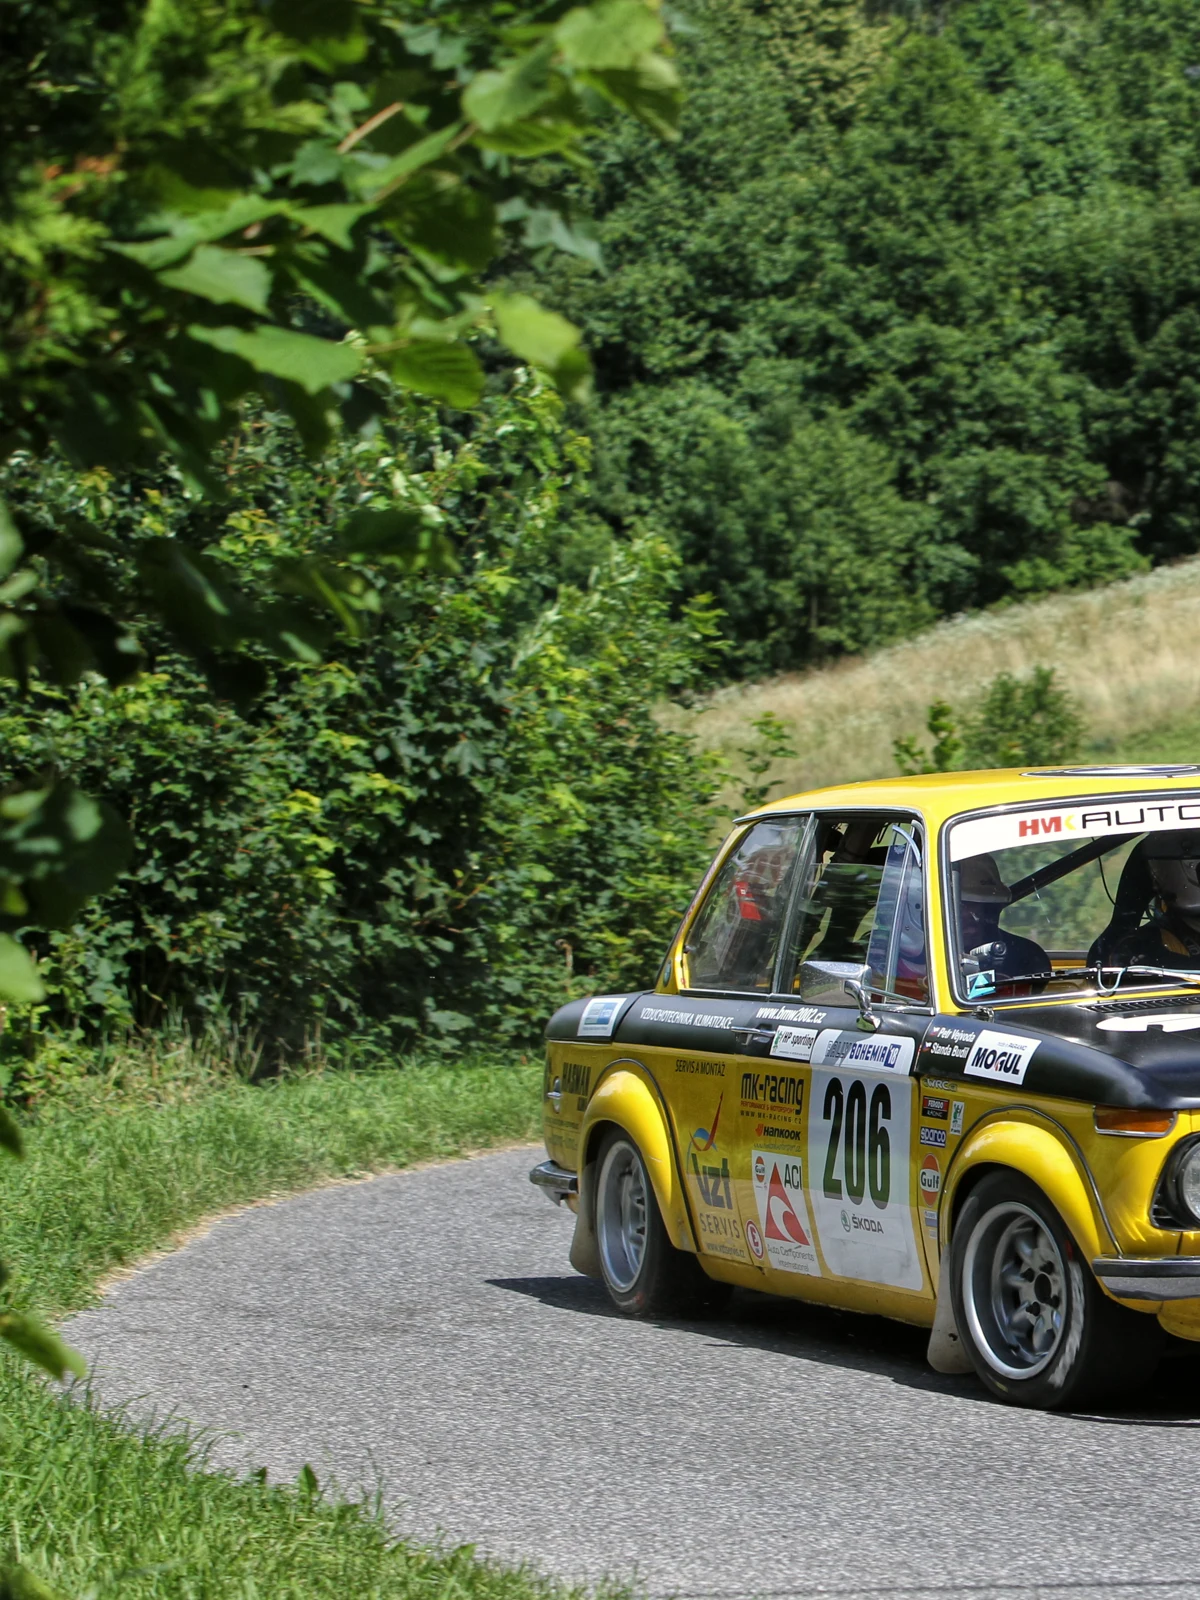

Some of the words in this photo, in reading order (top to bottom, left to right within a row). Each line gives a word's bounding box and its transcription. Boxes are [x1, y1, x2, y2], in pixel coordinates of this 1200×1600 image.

[640, 1008, 694, 1026] VZDUCHOTECHNIKA
[692, 1014, 734, 1030] KLIMATIZACE
[755, 1006, 826, 1025] www.bmw2002.cz
[790, 1034, 815, 1050] sporting
[937, 1027, 953, 1040] Petr
[951, 1028, 976, 1043] Vejvoda
[849, 1042, 888, 1063] BOHEMIA
[930, 1042, 952, 1056] Standa
[675, 1059, 695, 1074] SERVIS
[700, 1060, 726, 1077] MONTÁŽ
[971, 1047, 1022, 1076] MOGUL
[823, 1077, 892, 1210] 206
[920, 1127, 946, 1143] sparco
[784, 1163, 802, 1190] ACI
[920, 1171, 940, 1189] Gulf
[699, 1213, 740, 1239] SERVIS
[852, 1214, 884, 1234] ŠKODA
[767, 1243, 780, 1255] Auto
[780, 1246, 815, 1262] Components
